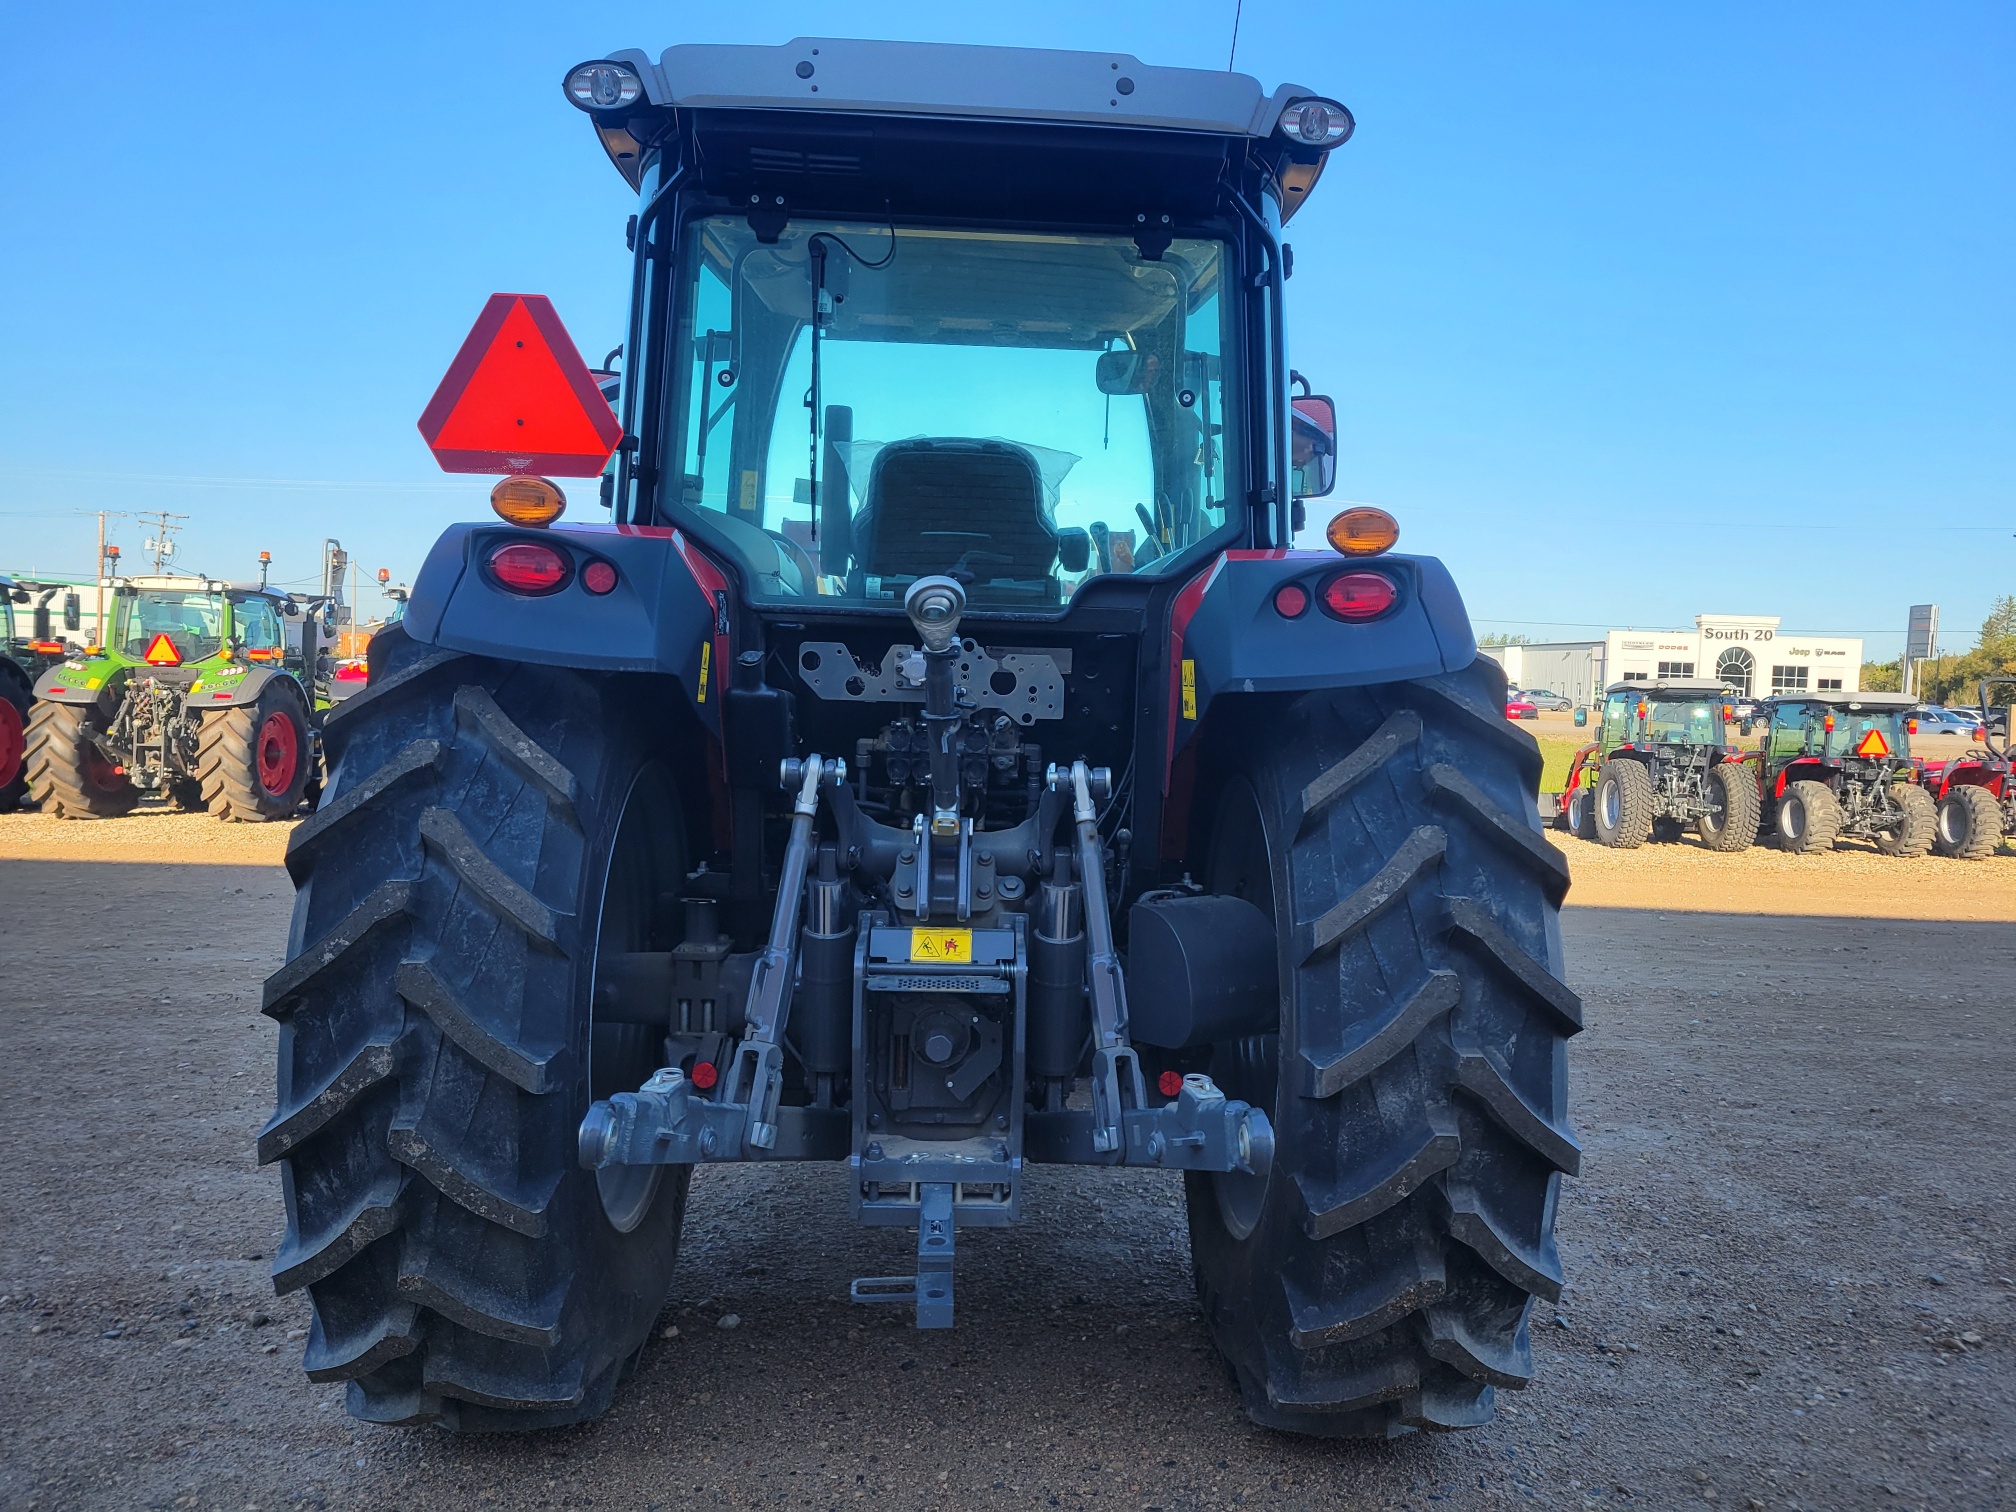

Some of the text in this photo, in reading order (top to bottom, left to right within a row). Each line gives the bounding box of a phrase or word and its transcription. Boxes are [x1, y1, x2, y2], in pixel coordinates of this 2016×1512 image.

[1704, 627, 1773, 641] South 20
[1789, 647, 1810, 657] Jeep
